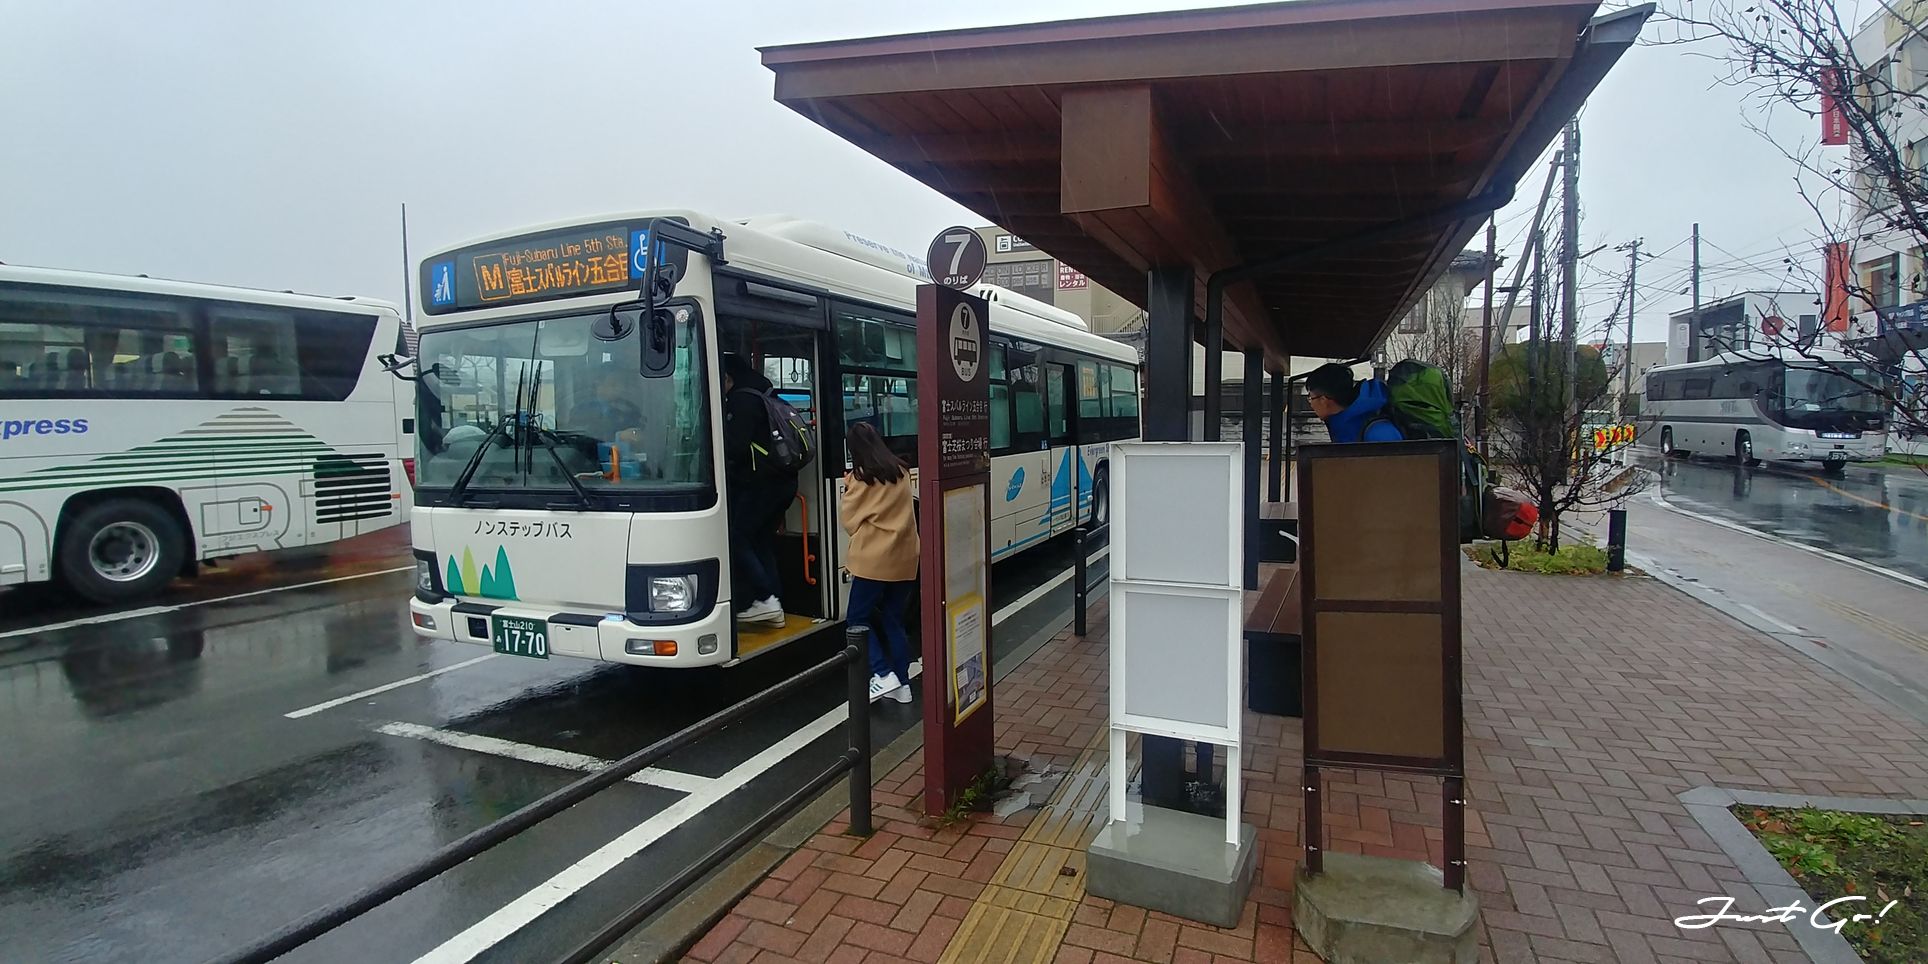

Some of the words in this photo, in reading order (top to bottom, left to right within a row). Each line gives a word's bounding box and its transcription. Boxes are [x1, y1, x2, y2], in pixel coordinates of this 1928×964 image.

[504, 246, 558, 266] Fuji-Subaru
[561, 243, 581, 258] Line
[584, 238, 603, 253] 5th
[606, 234, 628, 249] Sta.
[945, 234, 970, 275] 7
[481, 263, 503, 291] M
[507, 252, 628, 295] 富士スバルライン五合目
[943, 275, 969, 285] のりば
[1059, 279, 1086, 288] レンタル
[962, 308, 968, 328] 7
[475, 520, 572, 539] ノンステップバス
[504, 629, 545, 656] 17-70
